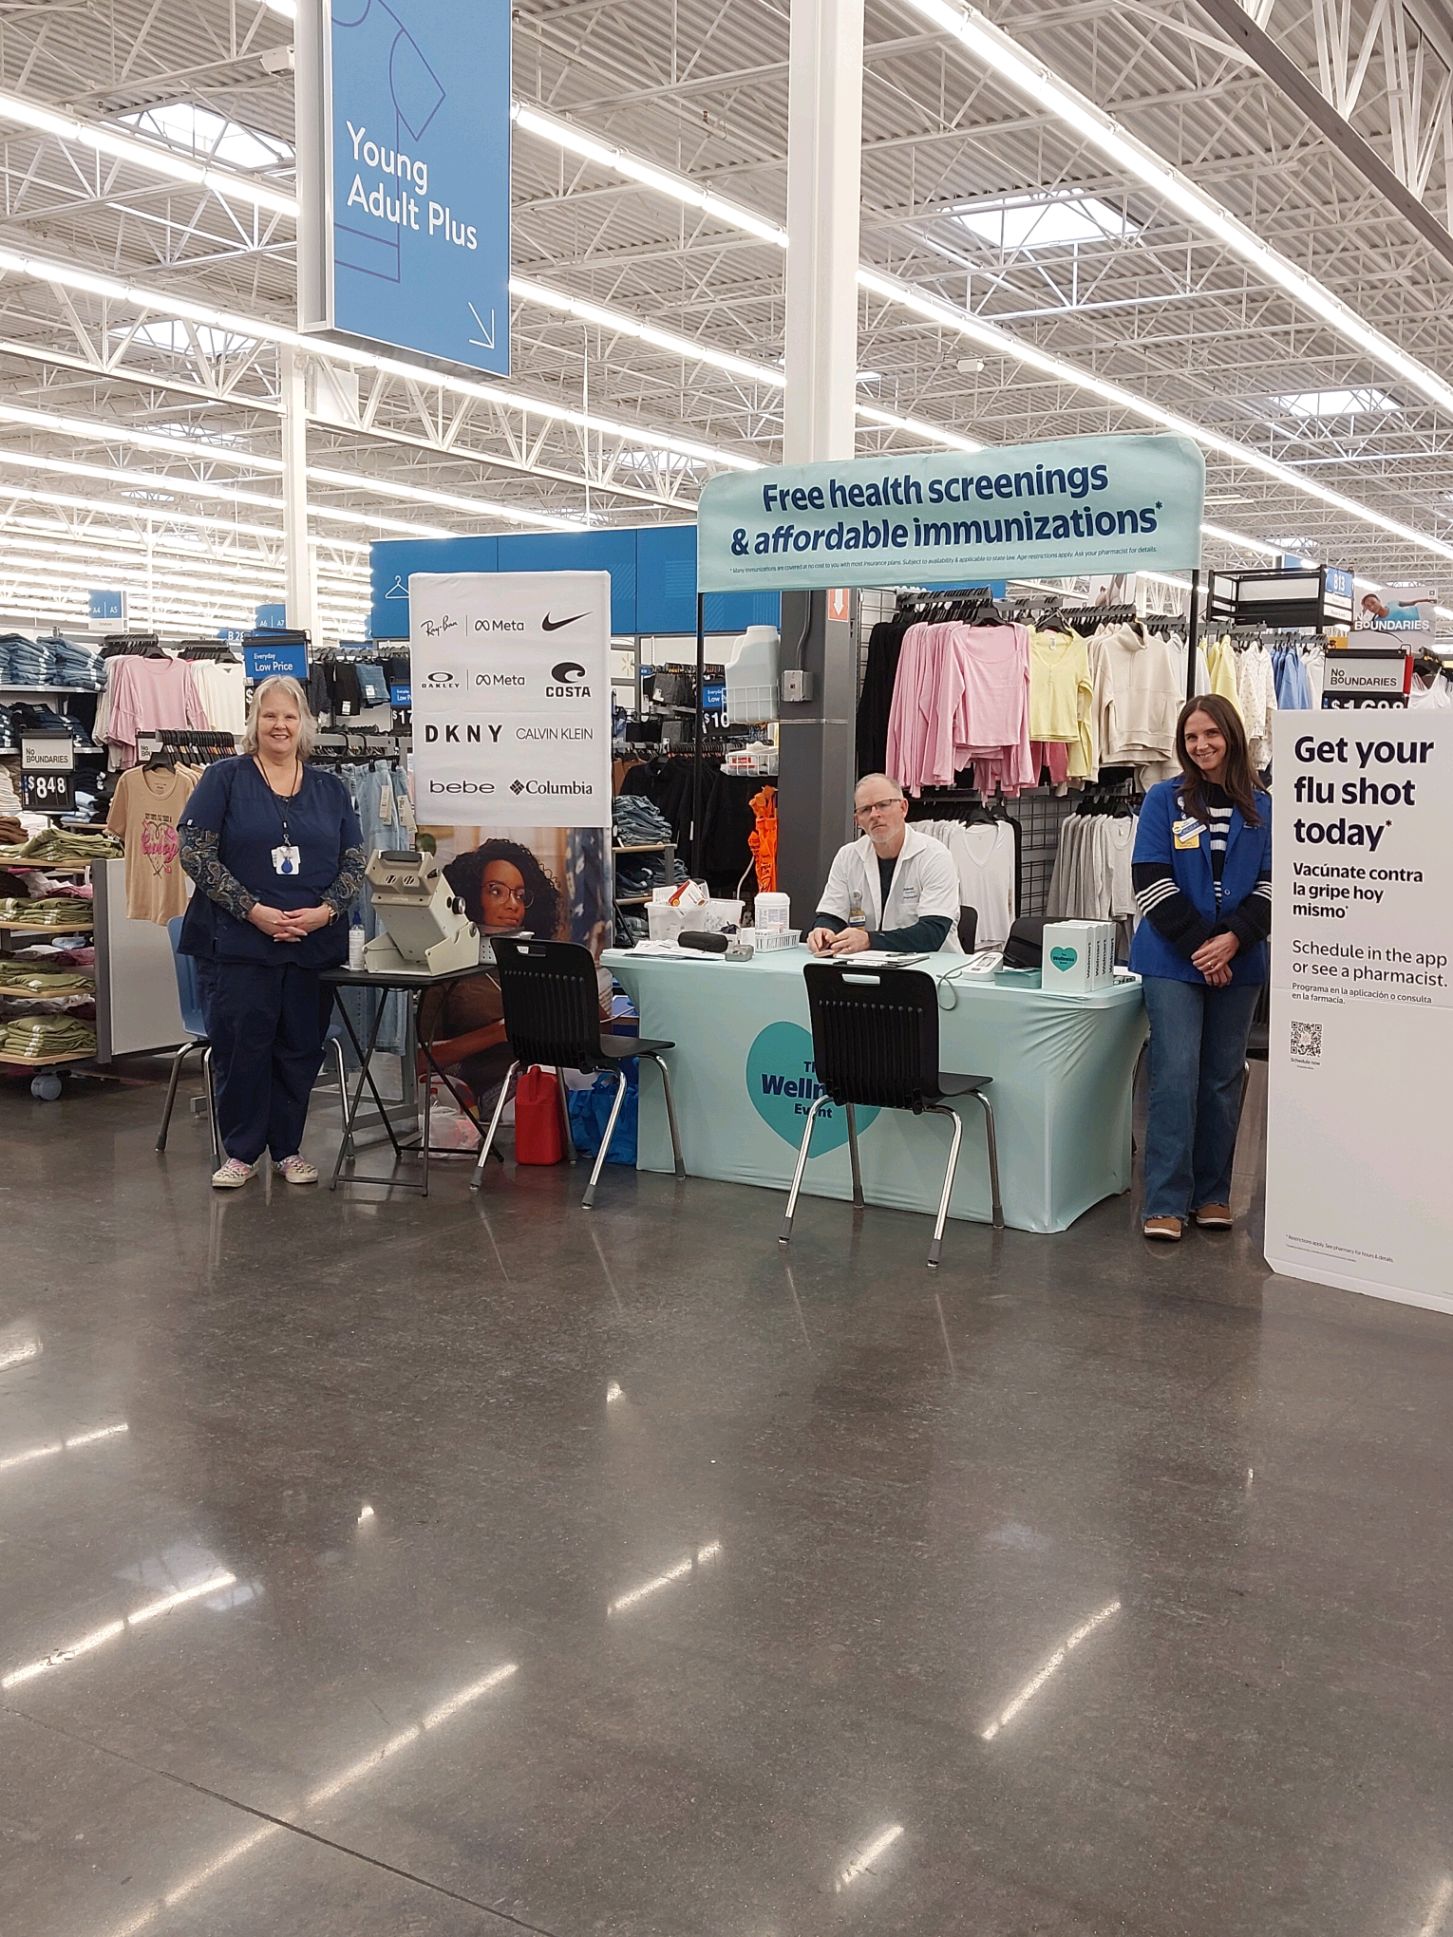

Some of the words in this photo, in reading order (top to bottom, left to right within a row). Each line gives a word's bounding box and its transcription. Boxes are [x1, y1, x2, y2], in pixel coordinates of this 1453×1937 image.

[346, 120, 428, 195] Young
[347, 173, 420, 231] Adult
[428, 201, 478, 250] Plus
[762, 482, 825, 513] Free
[829, 473, 923, 508] health
[928, 462, 1108, 504] screenings
[731, 528, 750, 556] &
[754, 517, 909, 555] affordable
[1098, 548, 1128, 556] pharmacist
[420, 615, 458, 637] Ray-Ban
[492, 620, 524, 631] Meta
[255, 662, 270, 672] Low
[273, 661, 293, 671] Price
[493, 675, 525, 686] Meta
[545, 686, 591, 698] COSTA
[425, 724, 502, 743] DKNY
[515, 728, 559, 740] CALVIN
[560, 728, 593, 740] KLEIN
[1294, 736, 1348, 763] Get
[1355, 740, 1434, 769] your
[429, 779, 495, 794] bebe
[525, 780, 593, 795] Columbia
[1294, 776, 1334, 804] flu
[1341, 777, 1416, 806] shot
[1293, 862, 1366, 880] Vacúnate
[1369, 868, 1423, 883] contra
[1293, 882, 1306, 896] la
[1309, 884, 1350, 901] gripe
[1353, 886, 1384, 903] hoy
[1292, 940, 1364, 959] Schedule
[1368, 946, 1382, 960] in
[1386, 948, 1412, 963] the
[1416, 952, 1448, 969] app
[1292, 962, 1308, 973] or
[1312, 964, 1338, 977] see
[1341, 967, 1349, 977] a
[1353, 966, 1448, 987] pharmacist.
[1292, 982, 1329, 994] Programa
[1330, 986, 1340, 994] en
[1341, 987, 1348, 995] la
[1349, 988, 1389, 1000] aplicación
[1397, 993, 1432, 1003] consulta
[1311, 993, 1345, 1004] farmacia.
